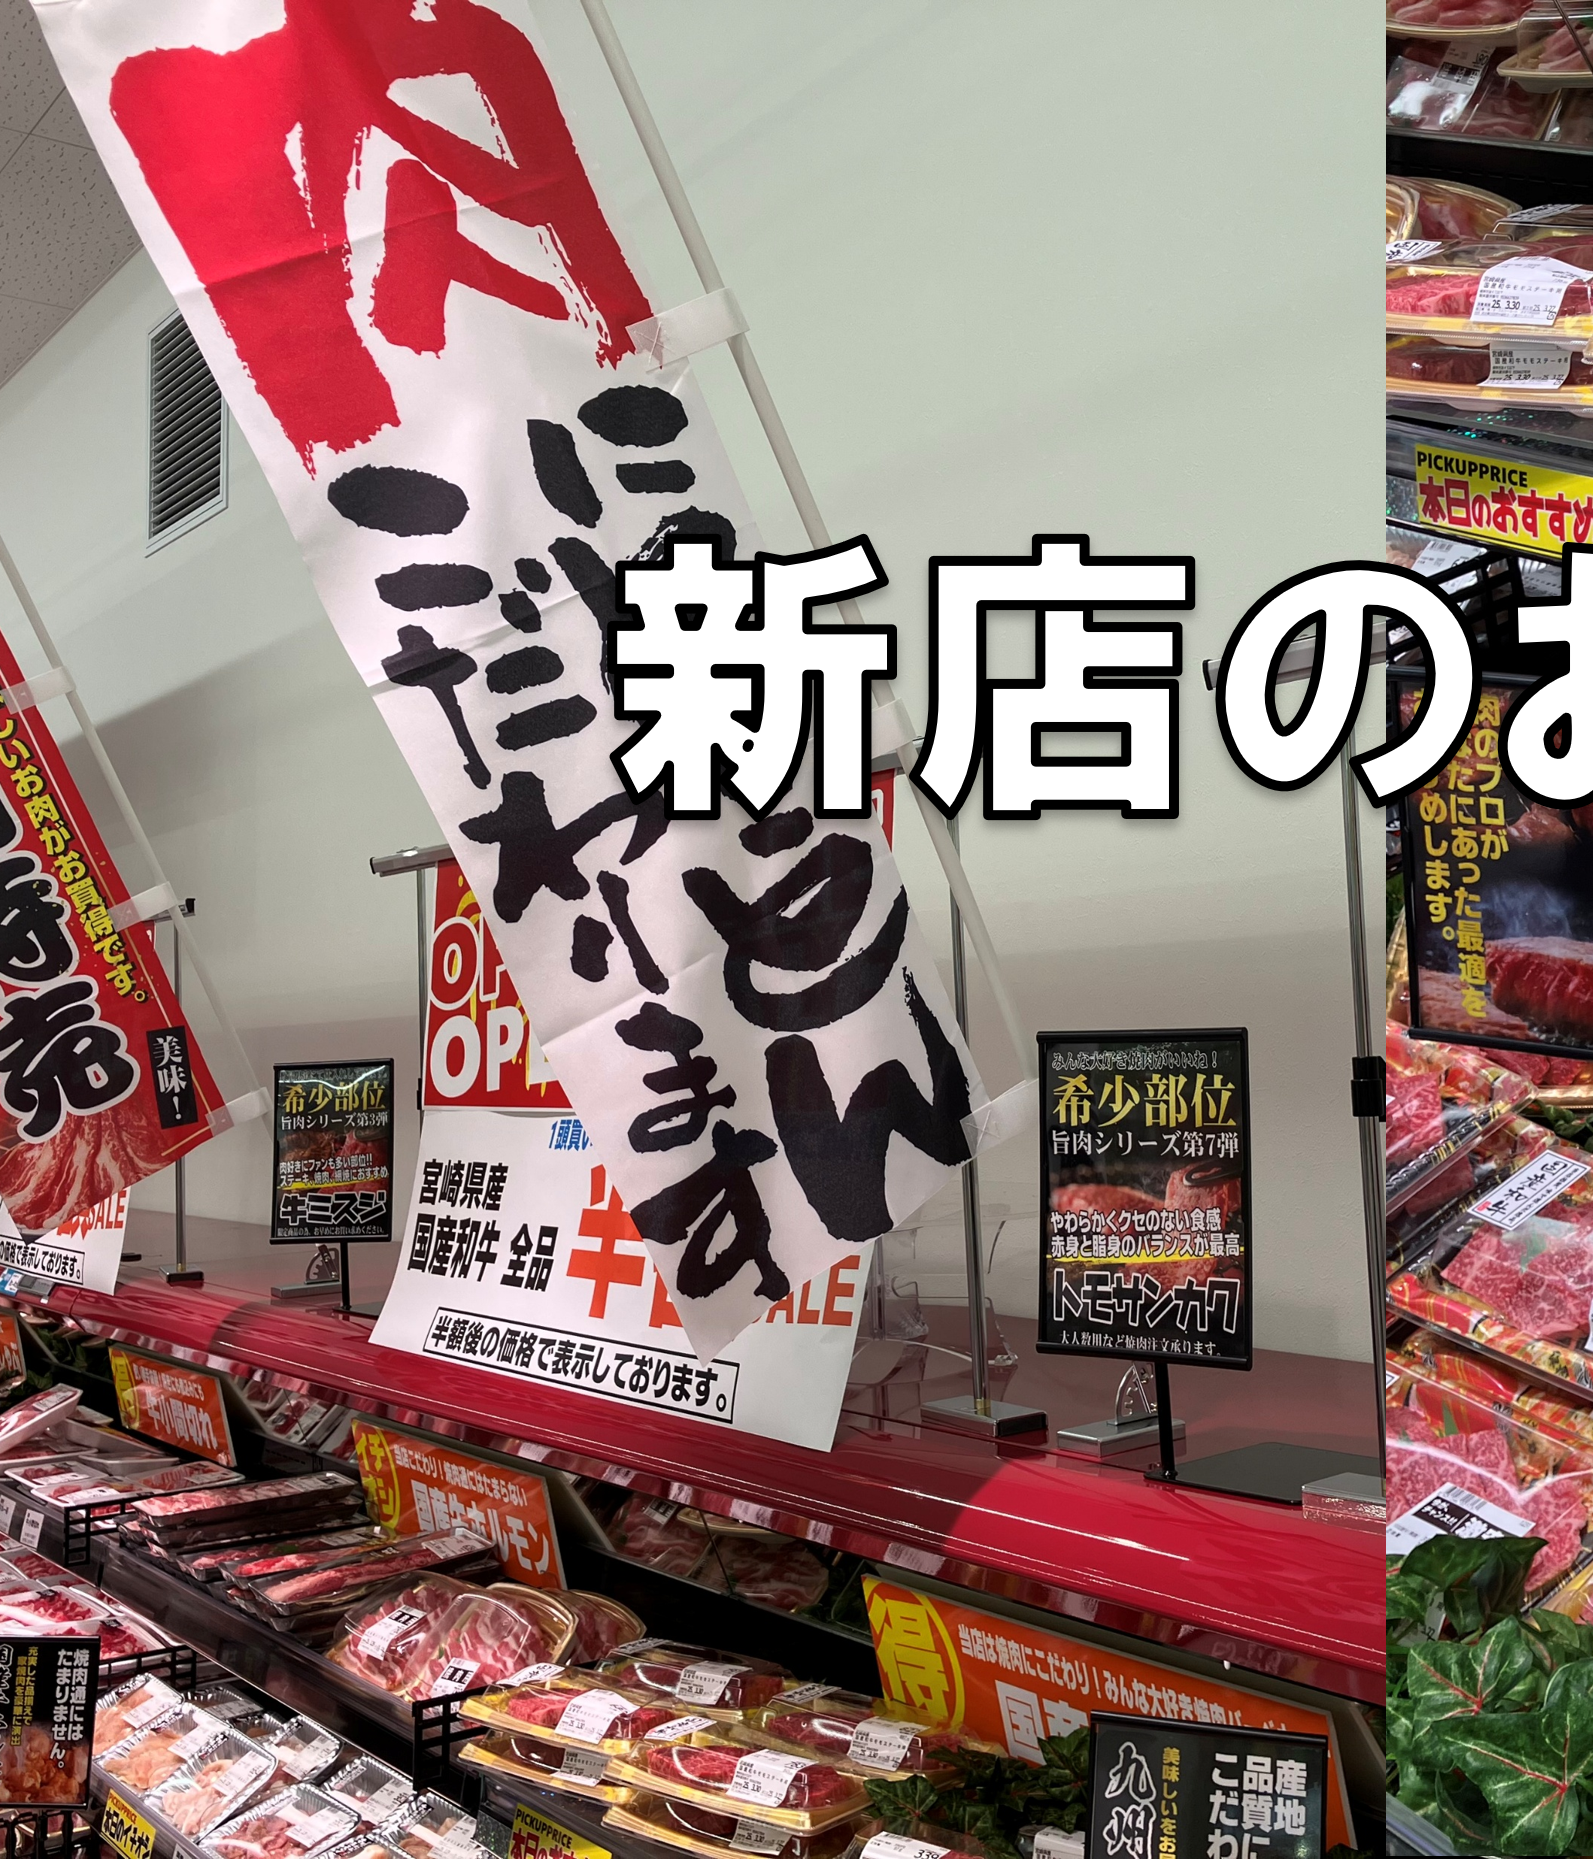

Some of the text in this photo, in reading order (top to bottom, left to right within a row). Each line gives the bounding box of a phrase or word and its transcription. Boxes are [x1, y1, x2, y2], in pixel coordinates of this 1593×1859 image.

[108, 0, 657, 480] 肉
[1416, 449, 1529, 489] PICKUPPRICE
[281, 1111, 388, 1131] 旨肉シリーズ第3弾
[283, 1080, 387, 1114] 希少部位
[1053, 1073, 1238, 1128] 希少部位
[1051, 1130, 1240, 1159] 旨肉シリーズ第7弾
[280, 1190, 387, 1226] 牛ミスジ
[418, 1157, 509, 1212] 宮崎県産
[1050, 1207, 1222, 1234] やわらかくクセのない食感
[1050, 1232, 1240, 1258] 赤身と脂身のバランスが最高
[406, 1213, 560, 1293] 国産和牛 全品
[765, 1252, 866, 1329] ALE
[1052, 1268, 1241, 1334] トモサンカク
[431, 1317, 728, 1414] 半額後の価格で表示しております。
[872, 1596, 951, 1706] 得
[50, 1648, 74, 1769] たまりません。
[66, 1648, 91, 1742] 焼肉通には
[1274, 1758, 1308, 1836] 産地
[515, 1808, 573, 1849] PICKUPPRICE
